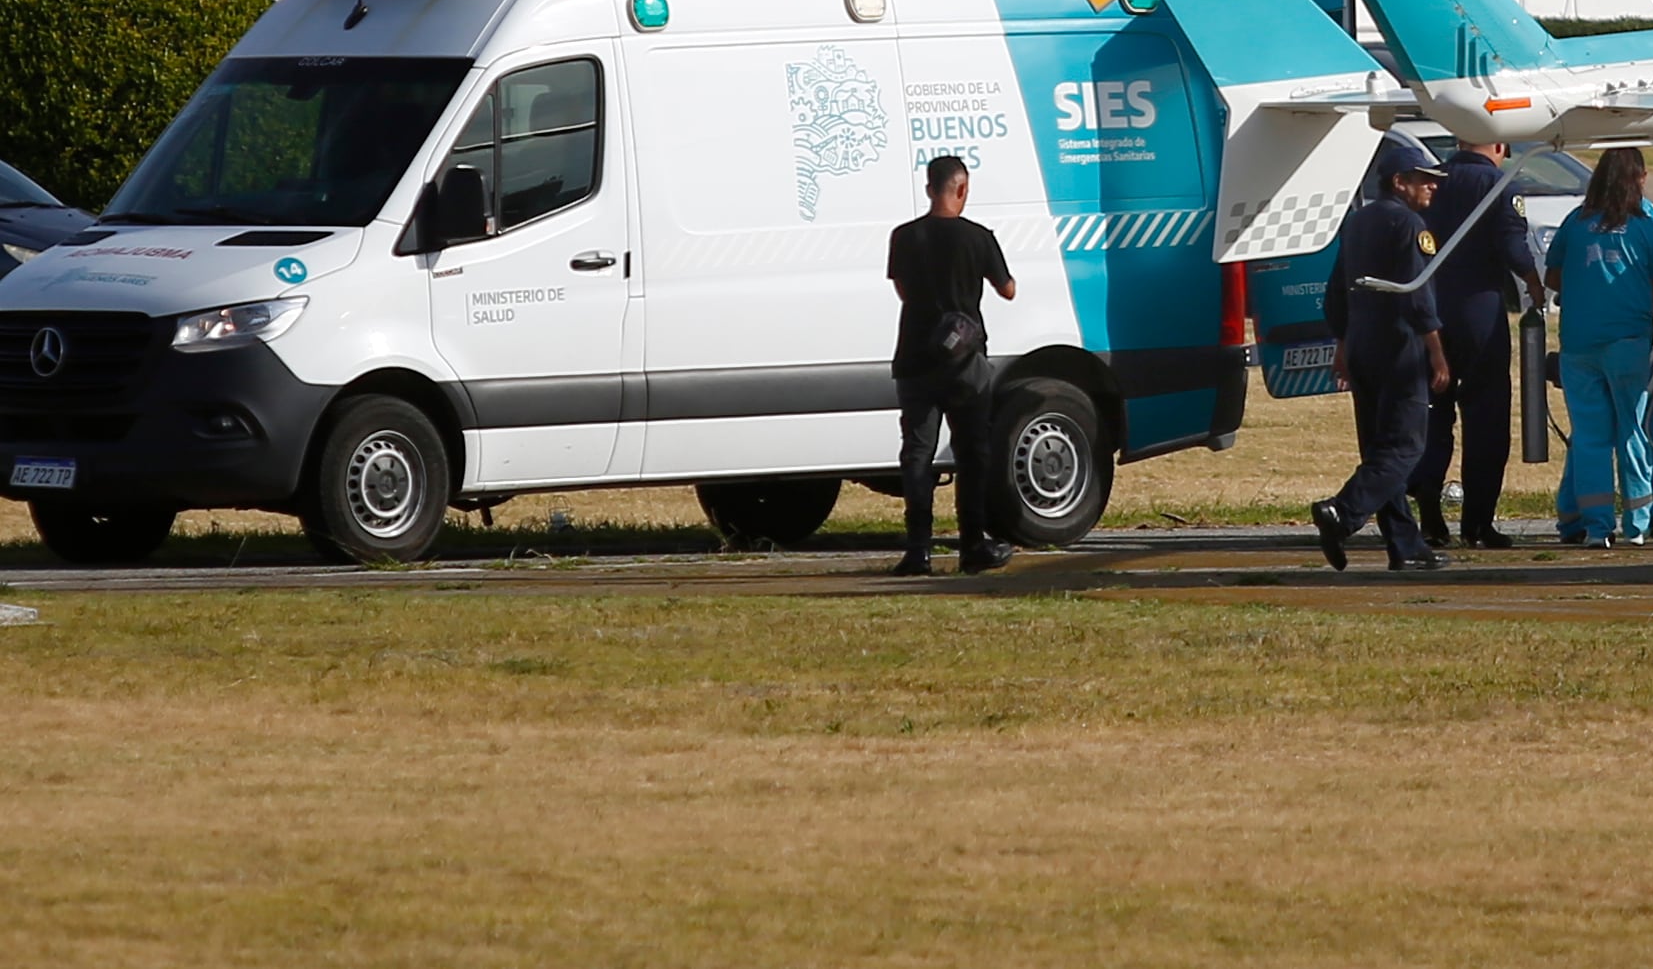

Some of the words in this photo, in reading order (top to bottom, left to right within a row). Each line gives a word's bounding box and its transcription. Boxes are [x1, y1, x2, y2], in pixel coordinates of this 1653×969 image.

[905, 82, 965, 97] GOBIERNO
[967, 82, 985, 95] DE
[986, 81, 1001, 94] LA
[907, 98, 970, 114] PROVINCIA
[971, 98, 988, 111] DE
[1053, 80, 1156, 131] SIES
[910, 113, 1008, 141] BUENOS
[1058, 138, 1091, 149] Sistema
[1092, 137, 1133, 150] Integrado
[1134, 136, 1145, 147] de
[1059, 152, 1112, 165] Emergencias
[1113, 150, 1155, 162] Sanitarias
[278, 261, 302, 279] 14
[472, 289, 545, 306] MINISTERIO
[547, 287, 565, 302] DE
[1282, 282, 1327, 296] MINISTERI
[473, 308, 515, 325] SALUD
[1284, 348, 1297, 367] AE
[30, 467, 54, 485] 722
[55, 469, 72, 486] TP
